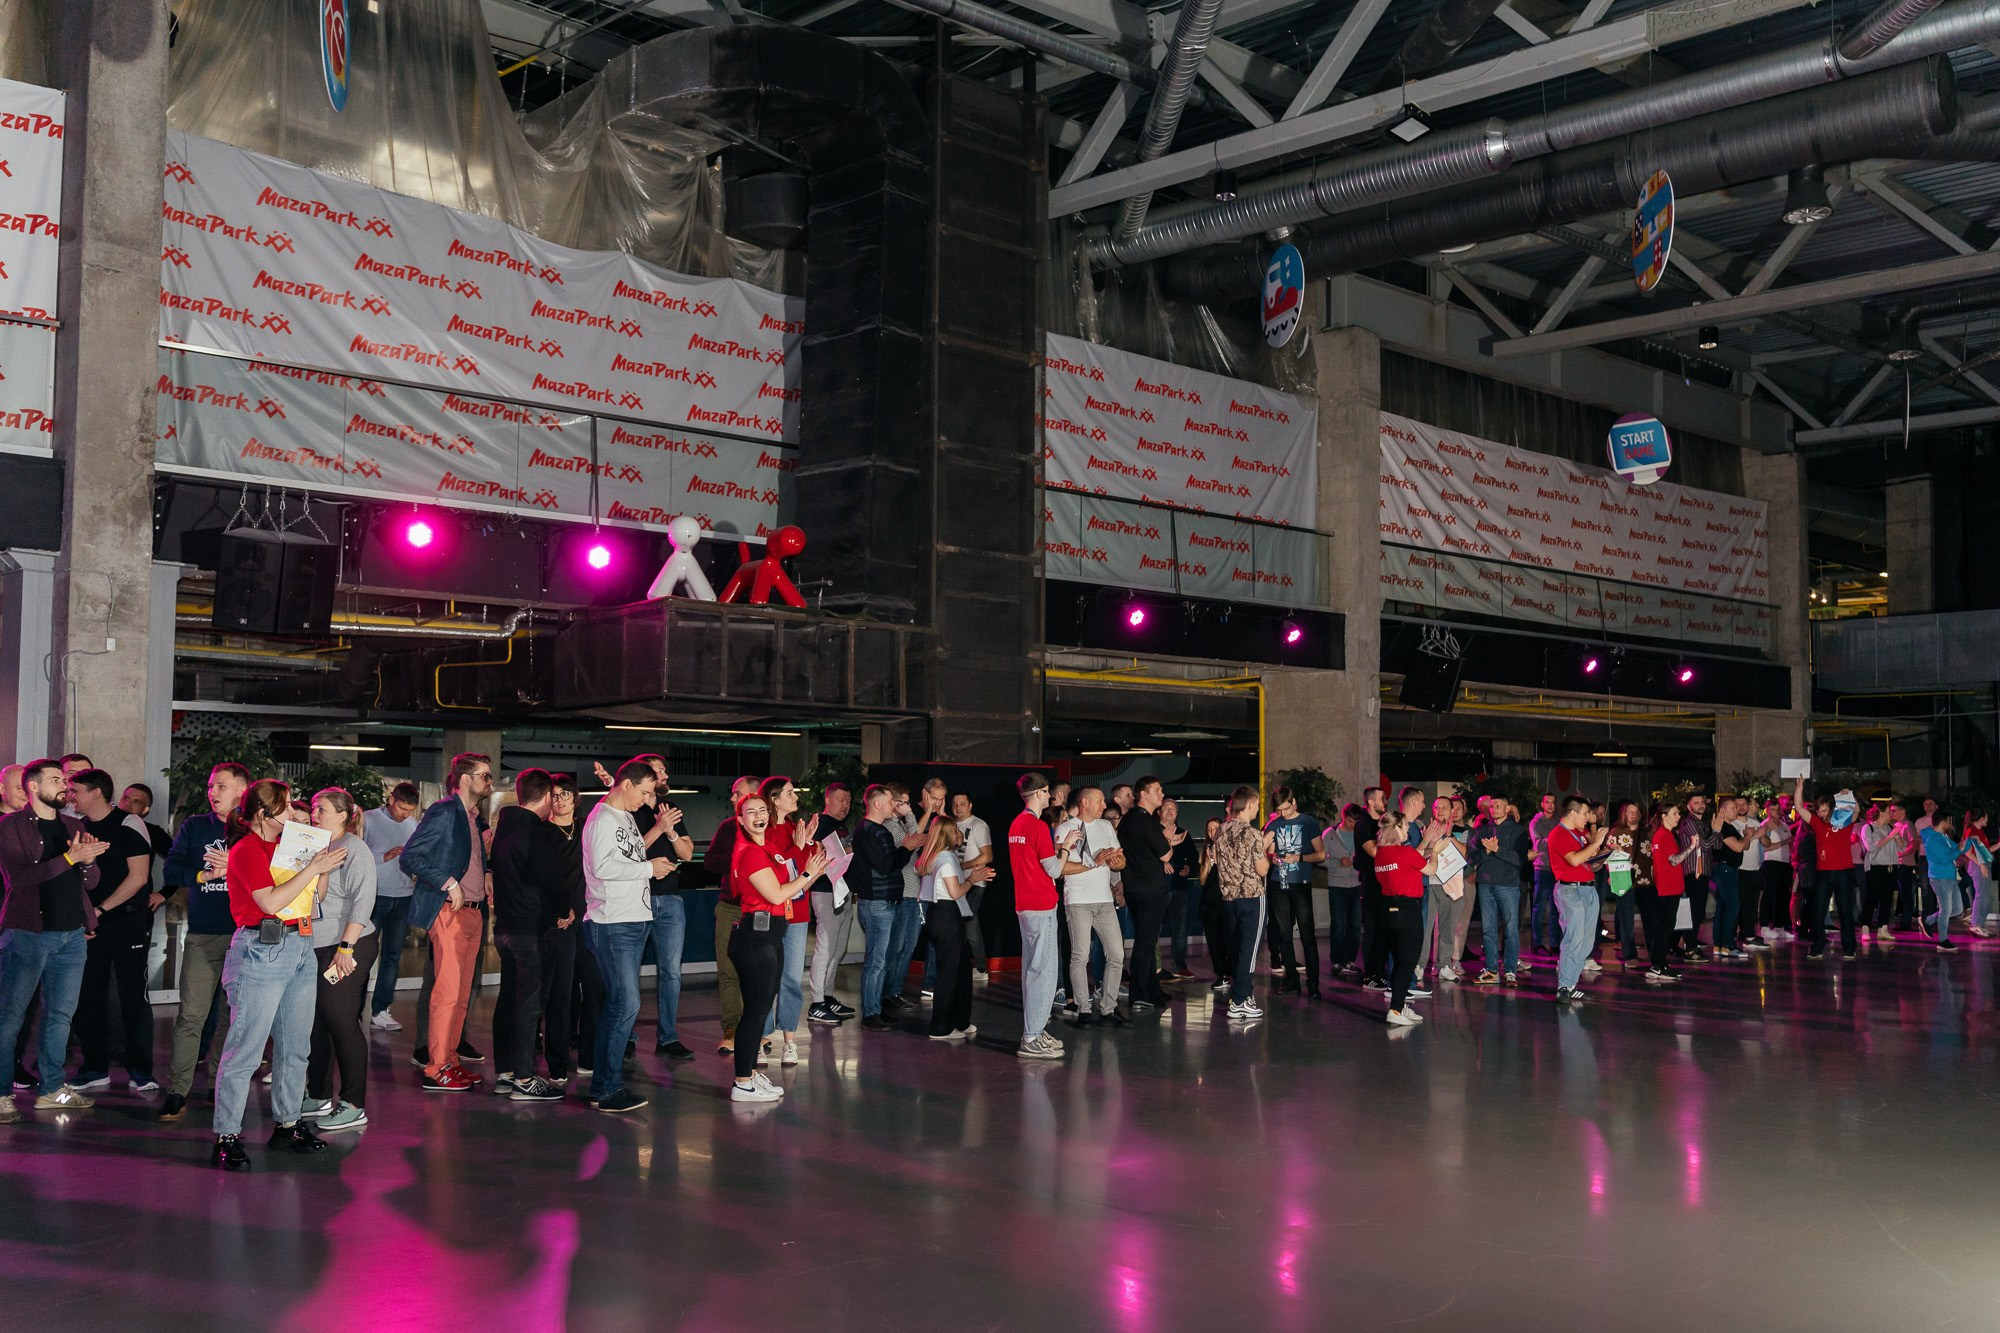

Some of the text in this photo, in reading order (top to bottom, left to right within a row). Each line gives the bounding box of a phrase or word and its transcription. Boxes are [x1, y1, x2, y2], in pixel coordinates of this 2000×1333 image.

[0, 113, 64, 139] zaPa
[256, 187, 361, 230] MazaPark
[447, 238, 537, 279] MazaPark
[354, 253, 452, 292] MazaPark
[252, 270, 356, 312] MazaPark
[613, 280, 691, 314] MazaPark
[531, 299, 616, 331] MazaPark
[447, 314, 536, 352] MazaPark
[349, 334, 450, 371] MazaPark
[688, 333, 763, 362] MazaPark
[611, 353, 692, 384] MazaPark
[532, 373, 617, 406] MazaPark
[1134, 377, 1187, 401] MazaPark
[441, 393, 535, 427] MazaPark
[687, 404, 763, 431] MazaPark
[1085, 395, 1138, 421] MazaPark
[1229, 400, 1276, 421] MazaPark
[346, 413, 445, 450] MazaPark
[1184, 418, 1235, 440] MazaPark
[1620, 430, 1656, 447] START
[611, 426, 692, 456] MazaPark
[1137, 436, 1190, 459] MazaPark
[1437, 440, 1474, 459] MazaPark
[240, 437, 349, 474] MazaPark
[1624, 444, 1656, 460] GAME
[1087, 455, 1141, 479] MazaPark
[1232, 455, 1278, 476] MazaPark
[1404, 455, 1441, 475] MazaPark
[1505, 457, 1540, 475] MazaPark
[437, 471, 530, 505] MazaPark
[687, 474, 760, 503] MazaPark
[1186, 475, 1237, 496] MazaPark
[1473, 472, 1509, 491] MazaPark
[1569, 472, 1599, 488] MazaPark
[1441, 488, 1476, 508] MazaPark
[1537, 487, 1571, 504] MazaPark
[1626, 484, 1656, 499] MazaPark
[607, 500, 683, 525] MazaPa
[1507, 504, 1541, 522] MazaPark
[1600, 500, 1630, 516] MazaPark
[1679, 496, 1706, 511] MazaPark
[1729, 505, 1755, 519] MazaPark
[1087, 515, 1144, 538] MazaPark
[1571, 517, 1602, 534] MazaPark
[1654, 511, 1683, 526] MazaPark
[1706, 521, 1732, 535] MazaPark
[1475, 520, 1510, 538] MazaPark
[1629, 528, 1658, 544] MazaPark
[1189, 532, 1236, 551] MazaPark
[1442, 534, 1479, 553] MazaPark
[1540, 533, 1574, 550] MazaPark
[1682, 538, 1709, 552] MazaPark
[1509, 549, 1543, 566] MazaPark
[1602, 544, 1632, 561] MazaPark
[1657, 554, 1684, 569] MazaPark
[1408, 553, 1448, 572] MazaPark
[1573, 560, 1605, 576] MazaPark
[1709, 562, 1733, 576] MazaPark
[1232, 567, 1279, 586] MazaPark
[1479, 567, 1513, 586] MazaPark
[1631, 570, 1661, 585] MazaPark
[1684, 578, 1711, 592] MazaPark
[1576, 605, 1607, 620] MazaPak
